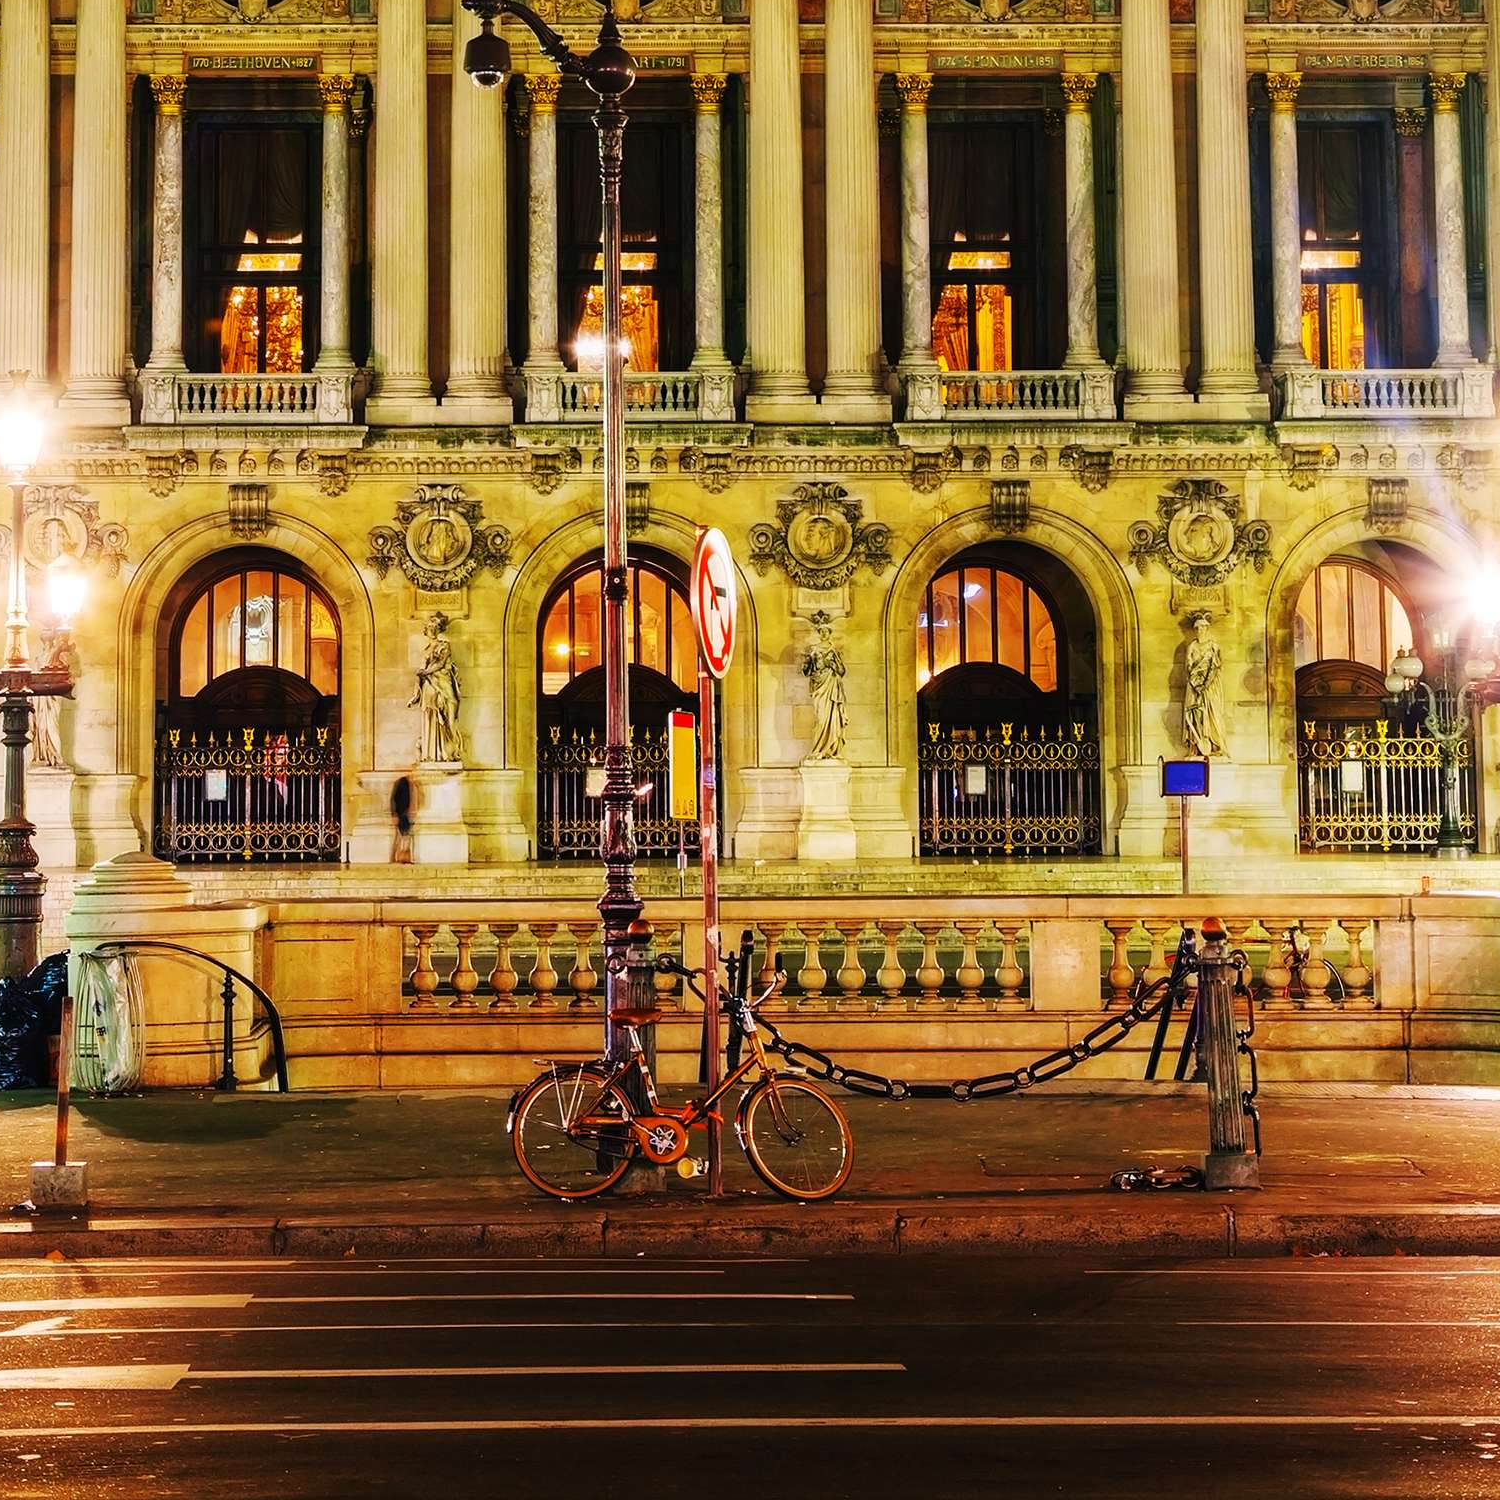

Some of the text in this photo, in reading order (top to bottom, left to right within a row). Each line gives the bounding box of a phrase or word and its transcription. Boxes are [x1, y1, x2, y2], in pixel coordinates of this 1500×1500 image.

[211, 56, 291, 69] BEETHOVEN
[667, 57, 685, 67] 1791
[963, 55, 1028, 68] SPONTINI
[1326, 55, 1403, 68] MEYERBEER
